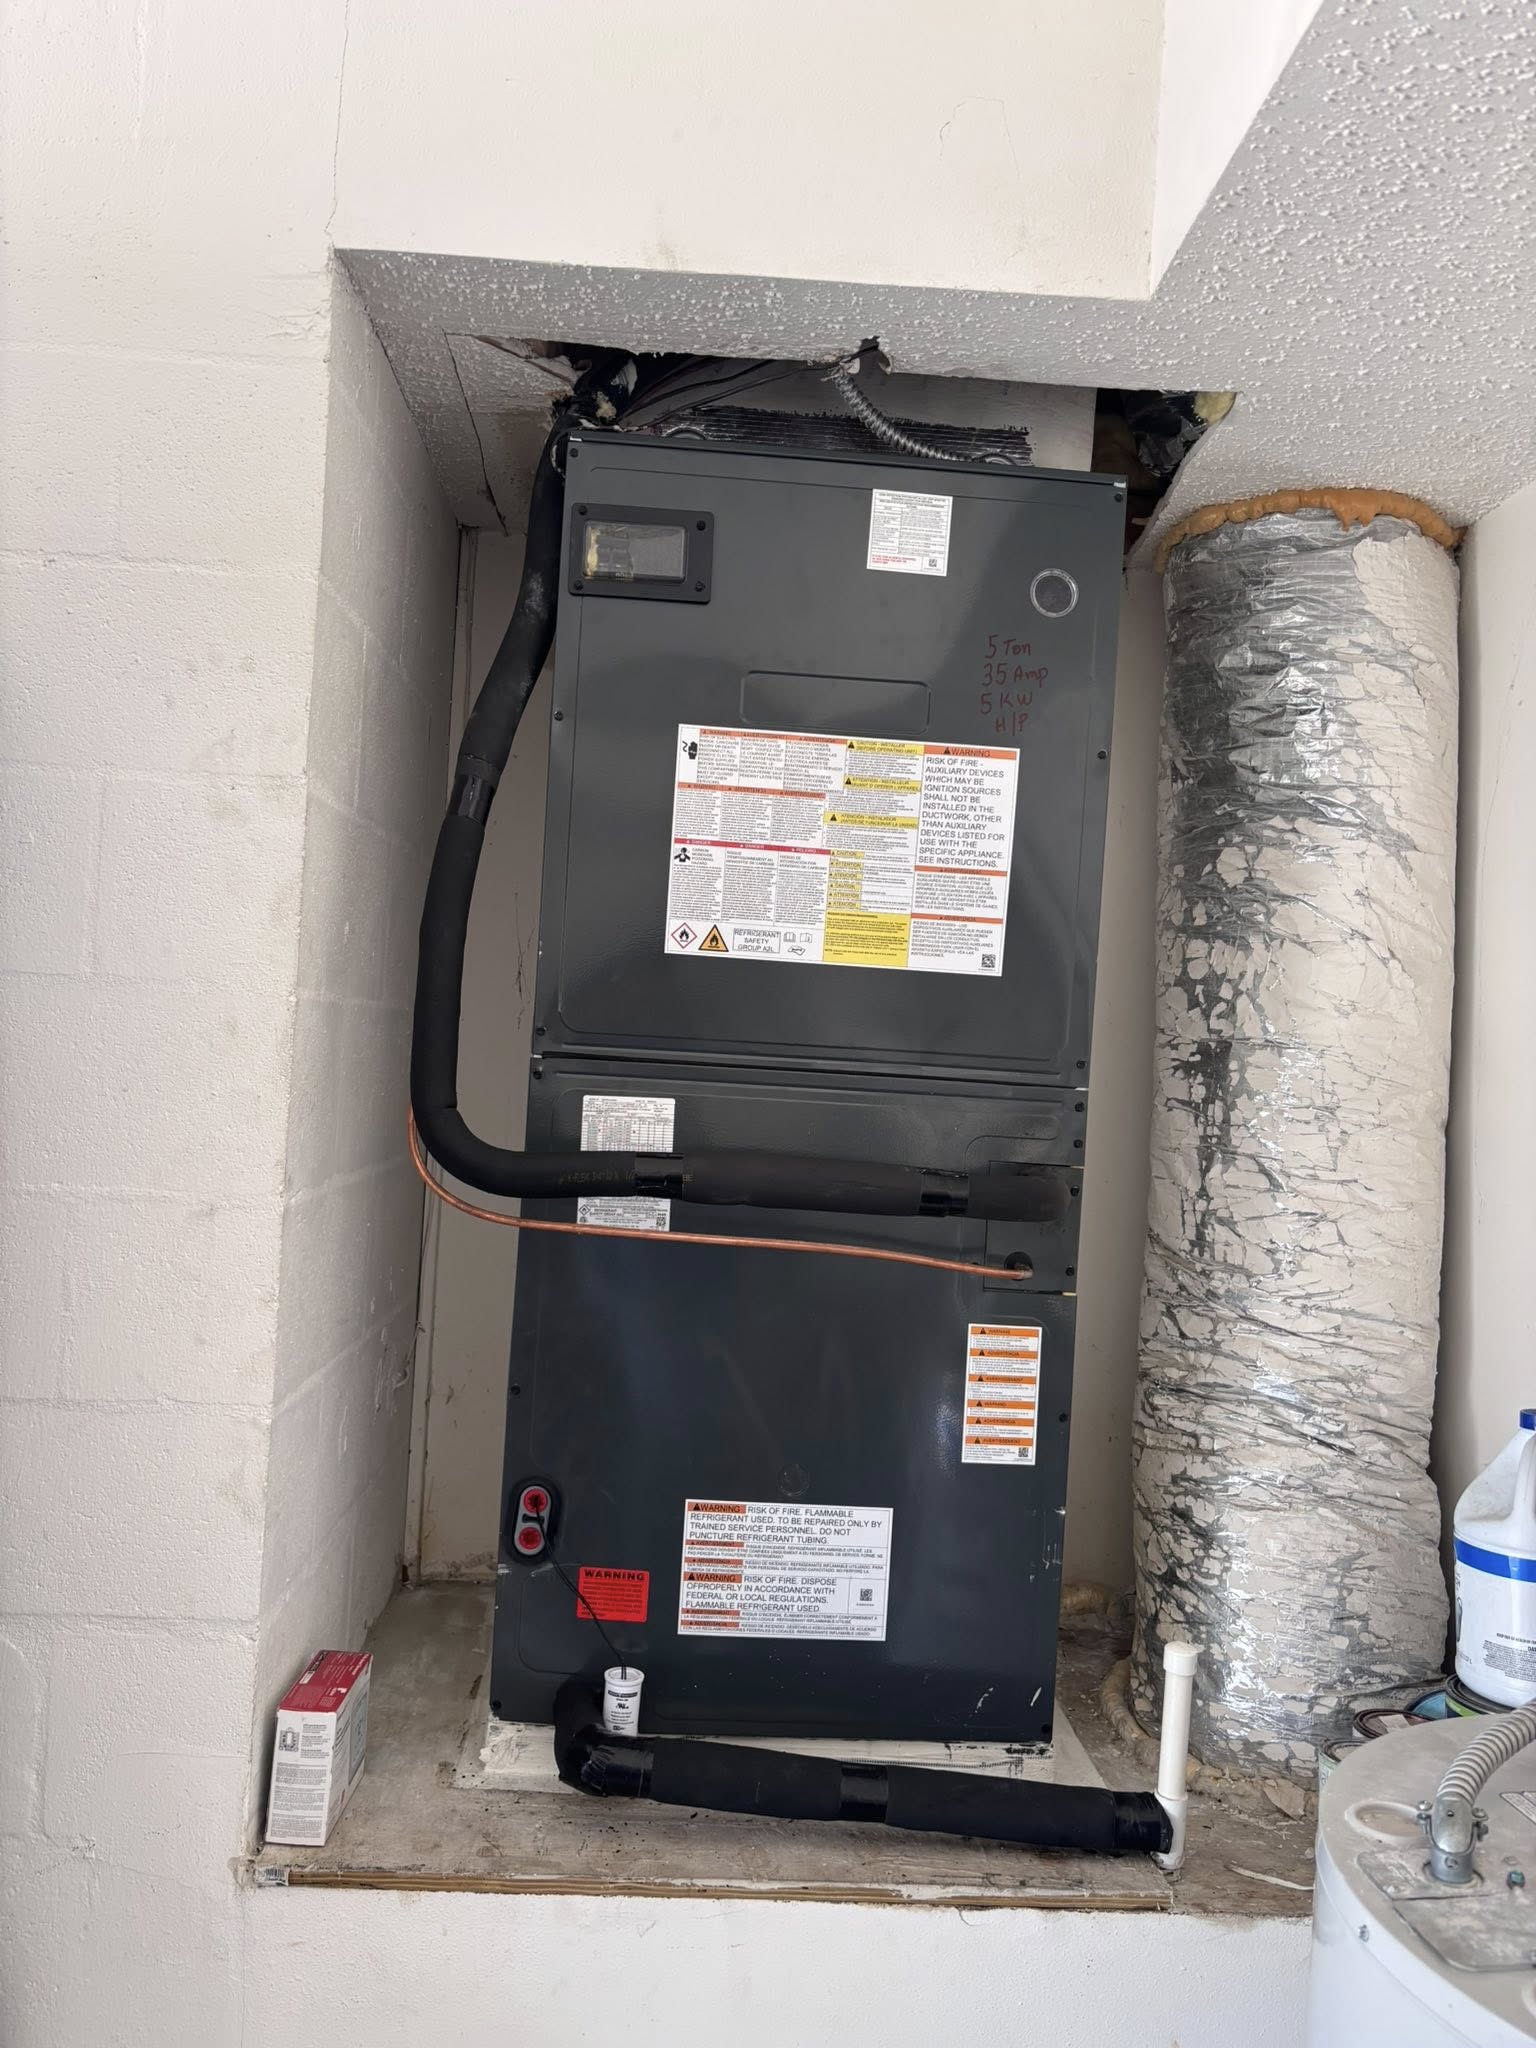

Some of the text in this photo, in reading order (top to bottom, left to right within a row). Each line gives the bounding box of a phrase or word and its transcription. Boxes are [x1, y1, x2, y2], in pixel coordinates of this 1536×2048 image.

[985, 634, 1031, 659] 5 Ton
[982, 662, 1049, 689] 35 Amp
[980, 692, 992, 714] 5
[952, 748, 990, 757] WARNING
[925, 765, 1004, 777] AUXILIARY DEVICES
[924, 774, 952, 783] WHICH
[954, 776, 972, 784] MAY
[924, 784, 960, 793] IGNITION
[962, 786, 1000, 795] SOURCES
[923, 793, 948, 801] SHALL
[922, 802, 966, 811] INSTALLED
[973, 814, 1001, 823] OTHER
[944, 821, 986, 830] AUXILIARY
[920, 828, 1004, 841] DEVICES LISTED FOR
[938, 839, 960, 847] WITH
[919, 846, 955, 855] SPECIFIC
[918, 855, 998, 868] SEE INSTRUCTIONS.
[734, 929, 779, 938] REFRIGERANT
[700, 1504, 740, 1512] WARNING
[747, 1506, 766, 1514] RISK
[804, 1508, 854, 1517] FLAMMABLE
[690, 1513, 748, 1522] REFRIGERANT
[777, 1516, 788, 1524] TO
[803, 1518, 845, 1526] REPAIRED
[847, 1519, 868, 1527] ONLY
[871, 1520, 882, 1528] BY
[690, 1522, 725, 1530] TRAINED
[727, 1523, 763, 1532] SERVICE
[819, 1527, 831, 1535] DO
[689, 1531, 733, 1540] PUNCTURE
[736, 1533, 793, 1542] REFRIGERANT
[584, 1569, 644, 1580] WARNING
[696, 1573, 736, 1582] WARNING
[743, 1575, 763, 1583] RISK
[801, 1577, 836, 1586] DISPOSE
[753, 1584, 812, 1594] ACCORDANCE
[813, 1587, 834, 1595] WITH
[686, 1591, 723, 1599] FEDERAL
[739, 1593, 766, 1601] LOCAL
[685, 1600, 734, 1609] FLAMMABLE
[736, 1602, 794, 1611] REFRIGERANT
